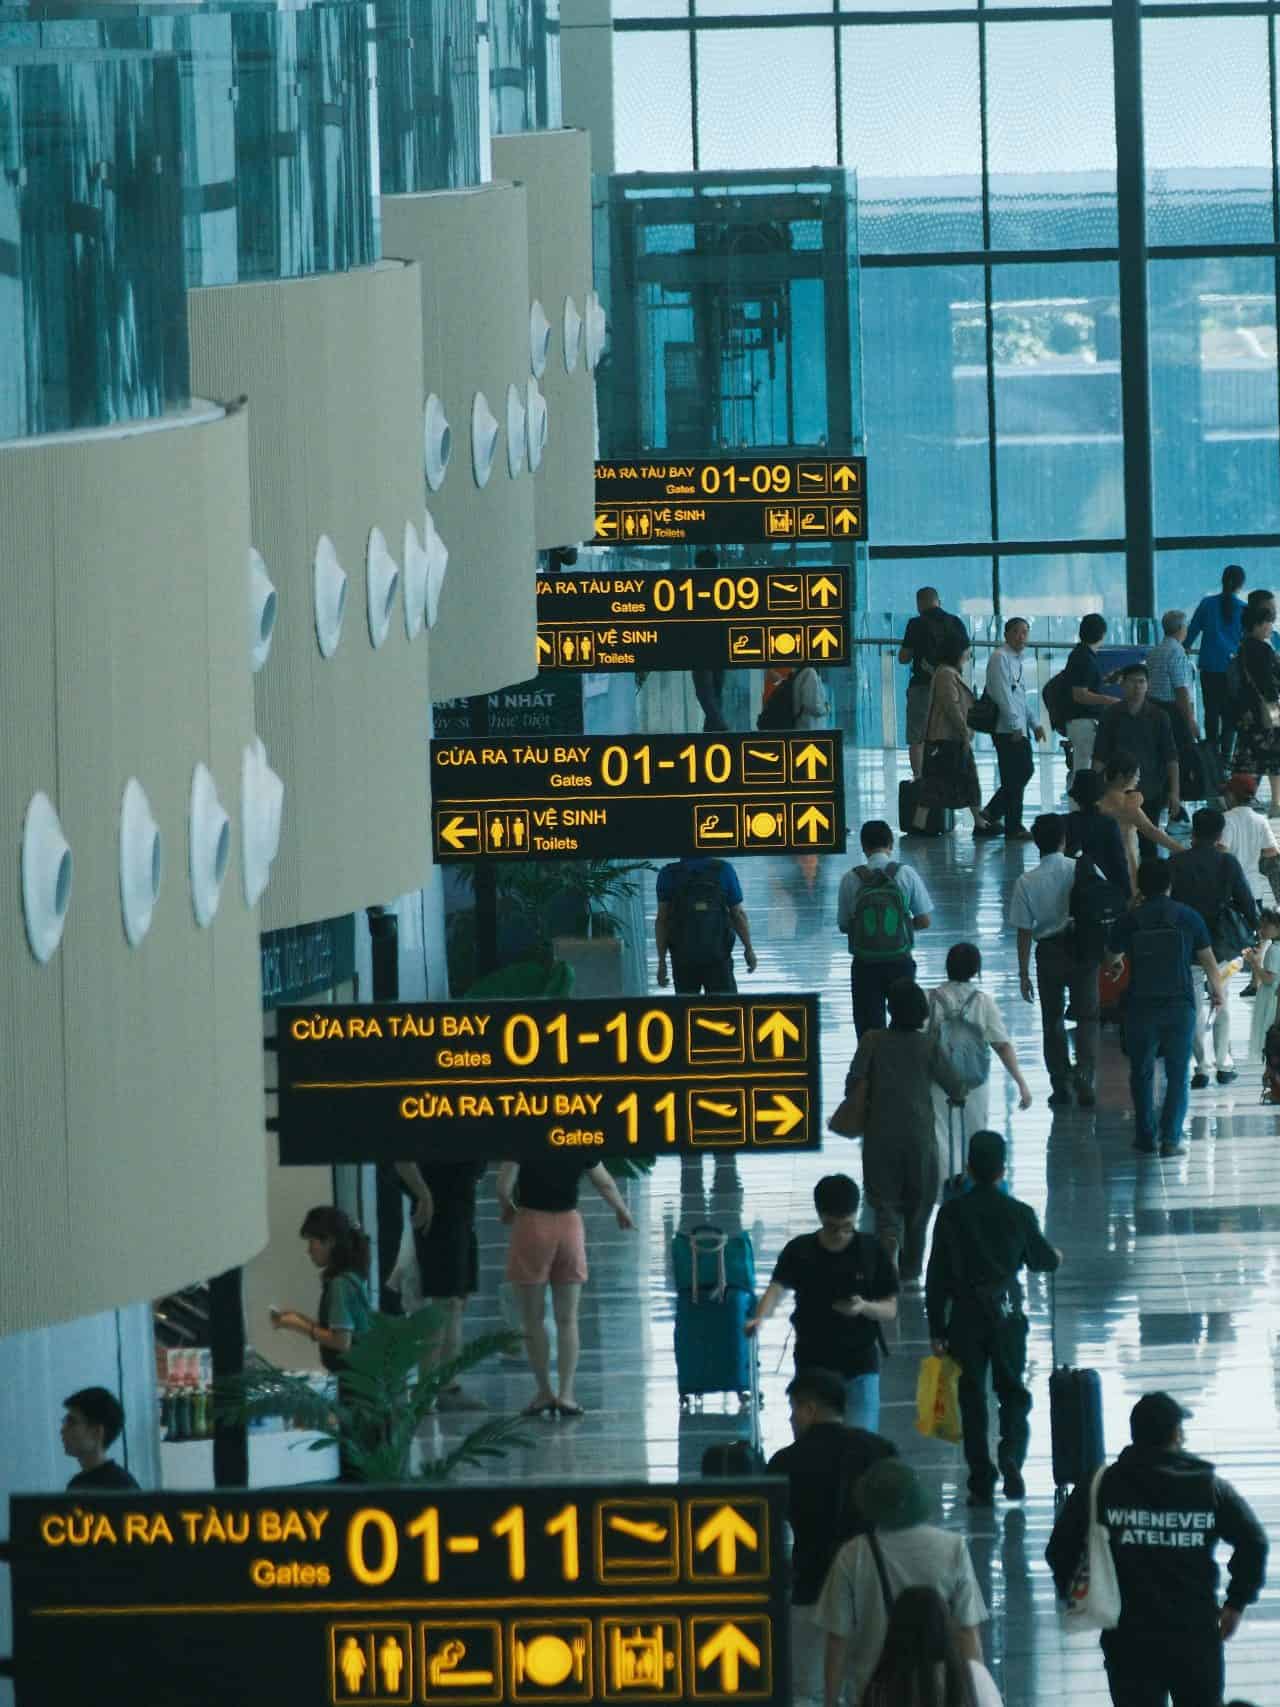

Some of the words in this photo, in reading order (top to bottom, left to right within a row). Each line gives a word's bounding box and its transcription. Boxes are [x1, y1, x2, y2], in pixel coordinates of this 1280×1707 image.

[619, 467, 638, 479] RA
[640, 465, 666, 479] TÀU
[669, 466, 695, 478] BAY
[701, 464, 791, 493] 01-09
[665, 484, 696, 494] Gates
[654, 508, 672, 524] VỆ
[674, 510, 706, 521] SINH
[654, 528, 686, 538] Toilets
[555, 581, 577, 594] RA
[580, 579, 610, 594] TÀU
[614, 580, 645, 593] BAY
[653, 577, 760, 612] 01-09
[611, 601, 647, 613] Gates
[597, 628, 618, 647] VỆ
[622, 630, 658, 644] SINH
[597, 652, 635, 664] Toilets
[436, 746, 476, 766] CỬA
[482, 748, 508, 765] RA
[512, 745, 549, 764] TÀU
[553, 747, 591, 764] BAY
[600, 743, 732, 787] 01-10
[549, 774, 593, 788] Gates
[533, 807, 559, 829] VỆ
[562, 808, 607, 826] SINH
[533, 836, 578, 851] Toilets
[291, 1014, 345, 1041] CỬA
[348, 1016, 384, 1039] RA
[388, 1012, 437, 1038] TÀU
[441, 1014, 491, 1037] BAY
[503, 1009, 674, 1066] 01-10
[437, 1048, 493, 1069] Gates
[400, 1092, 453, 1120] CỬA
[459, 1095, 495, 1118] RA
[499, 1091, 549, 1117] TÀU
[554, 1093, 603, 1116] BAY
[616, 1091, 677, 1144] 11
[548, 1126, 605, 1147] Gates
[41, 1507, 118, 1547] CỬA
[124, 1512, 175, 1545] RA
[180, 1505, 251, 1544] TÀU
[259, 1509, 330, 1543] BAY
[347, 1504, 580, 1585] 01-11
[1121, 1529, 1205, 1547] ATELIER
[251, 1558, 332, 1588] Gates
